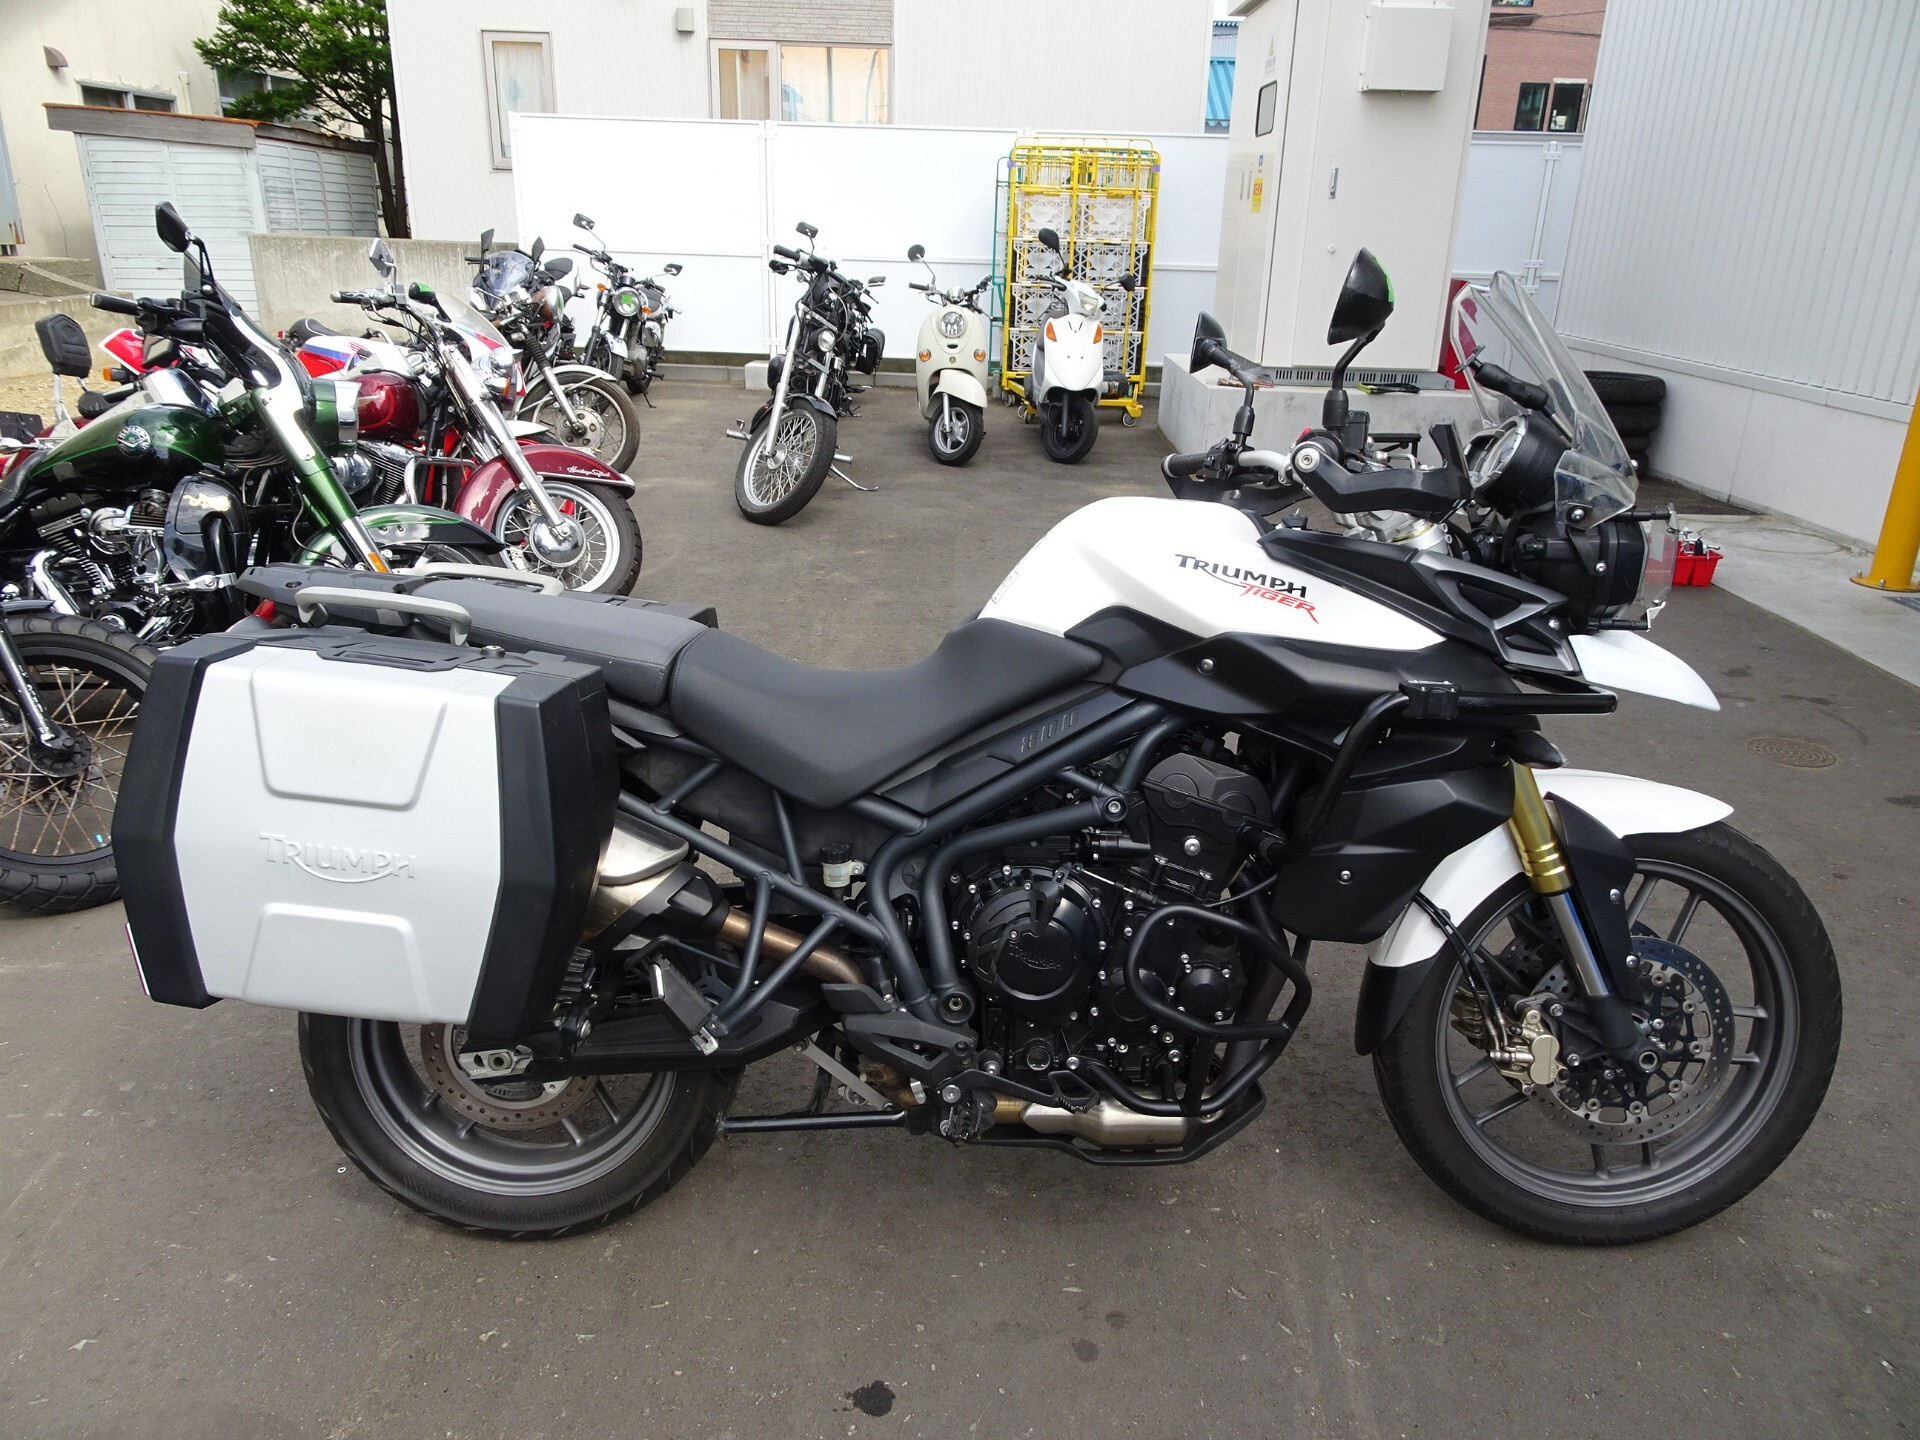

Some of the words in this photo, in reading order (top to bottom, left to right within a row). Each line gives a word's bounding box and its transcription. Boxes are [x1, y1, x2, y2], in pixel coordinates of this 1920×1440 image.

[1175, 554, 1307, 598] TRIUMPH
[1239, 582, 1319, 624] TIGER
[259, 832, 416, 883] TRIUMPH
